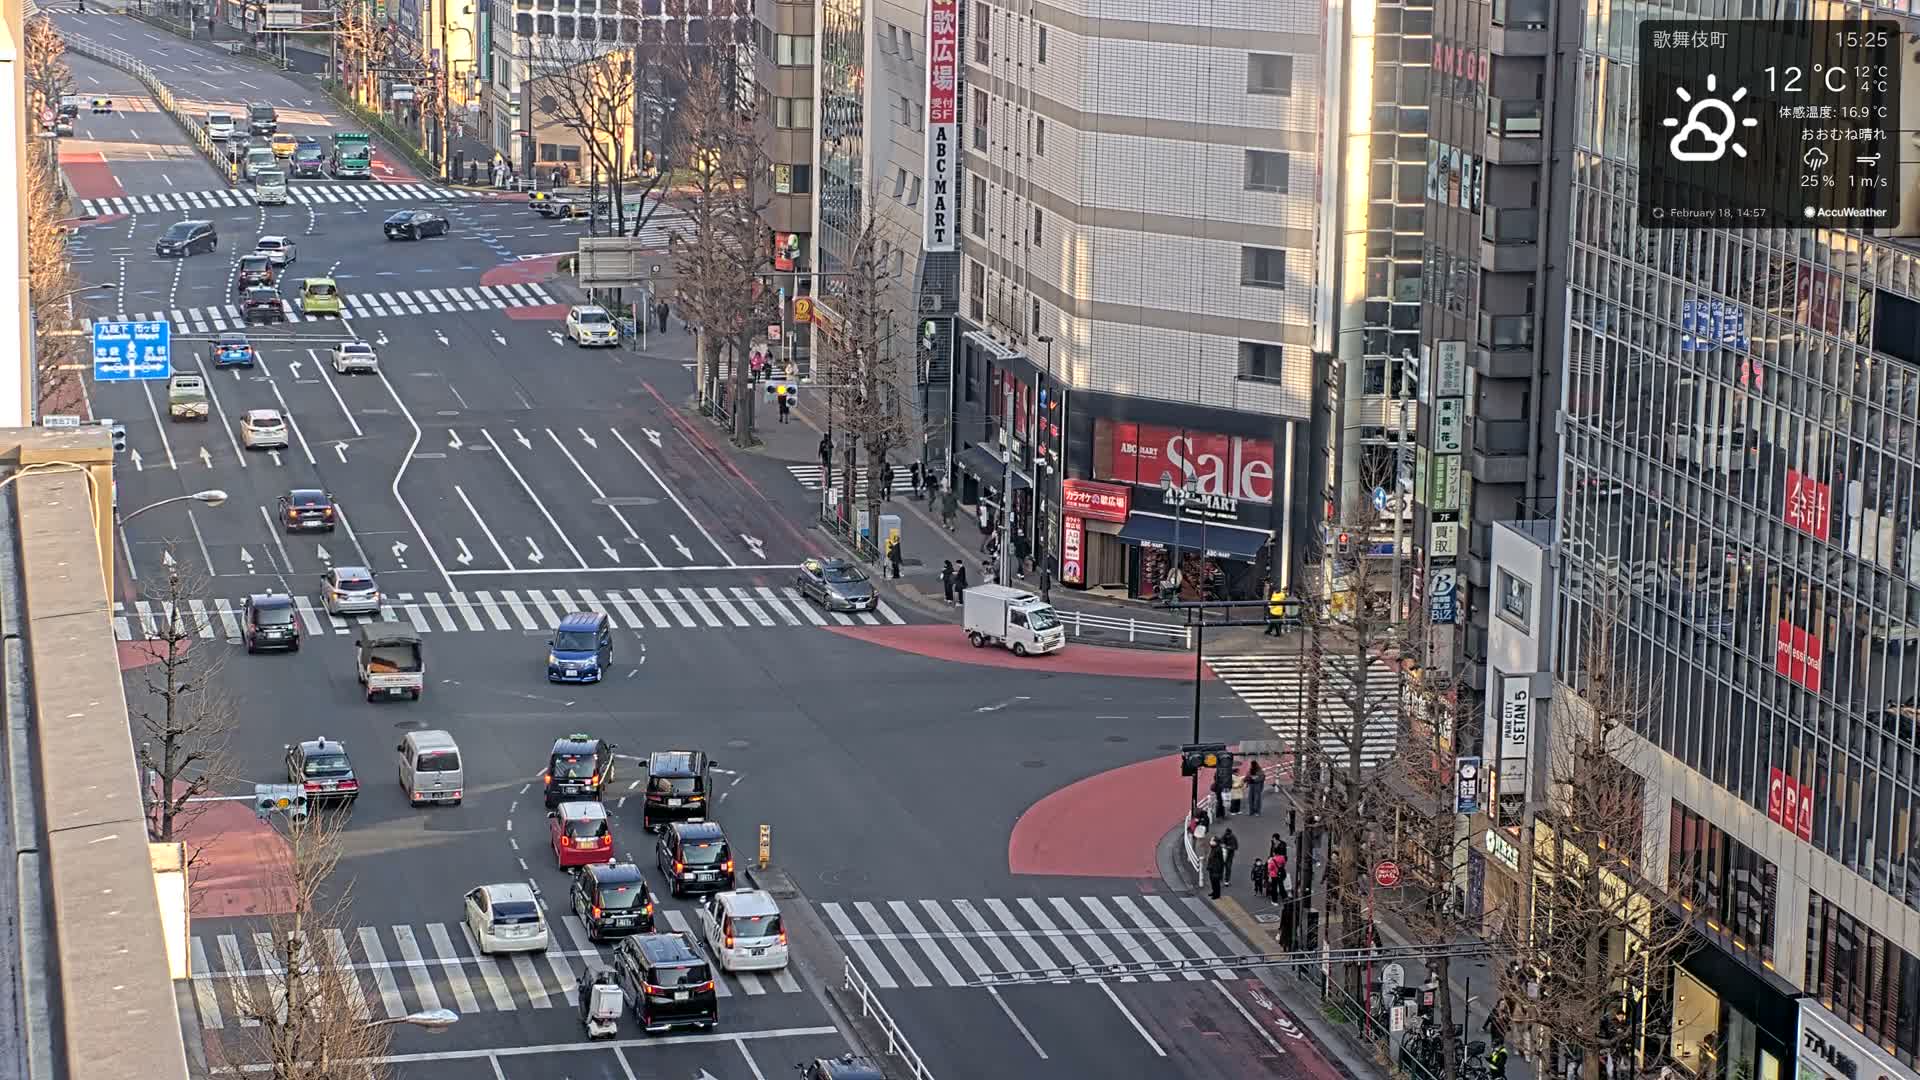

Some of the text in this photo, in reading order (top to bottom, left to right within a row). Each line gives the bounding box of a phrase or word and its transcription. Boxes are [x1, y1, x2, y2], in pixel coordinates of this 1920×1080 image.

[933, 10, 954, 91] 歌広場
[1434, 42, 1487, 81] AMIGO
[931, 97, 953, 109] 受付
[931, 110, 953, 120] 5F
[934, 127, 947, 243] ABC-MART
[100, 325, 129, 334] 九段下
[1166, 435, 1273, 504] Sale
[1066, 491, 1092, 503] カラオケ
[1790, 481, 1825, 530] 会計
[1434, 526, 1448, 552] 買取
[1431, 610, 1452, 620] BiZ
[1778, 640, 1822, 671] professional
[1505, 701, 1513, 719] CITY
[1513, 690, 1527, 745] ISETAN 5
[1771, 778, 1811, 828] CPA
